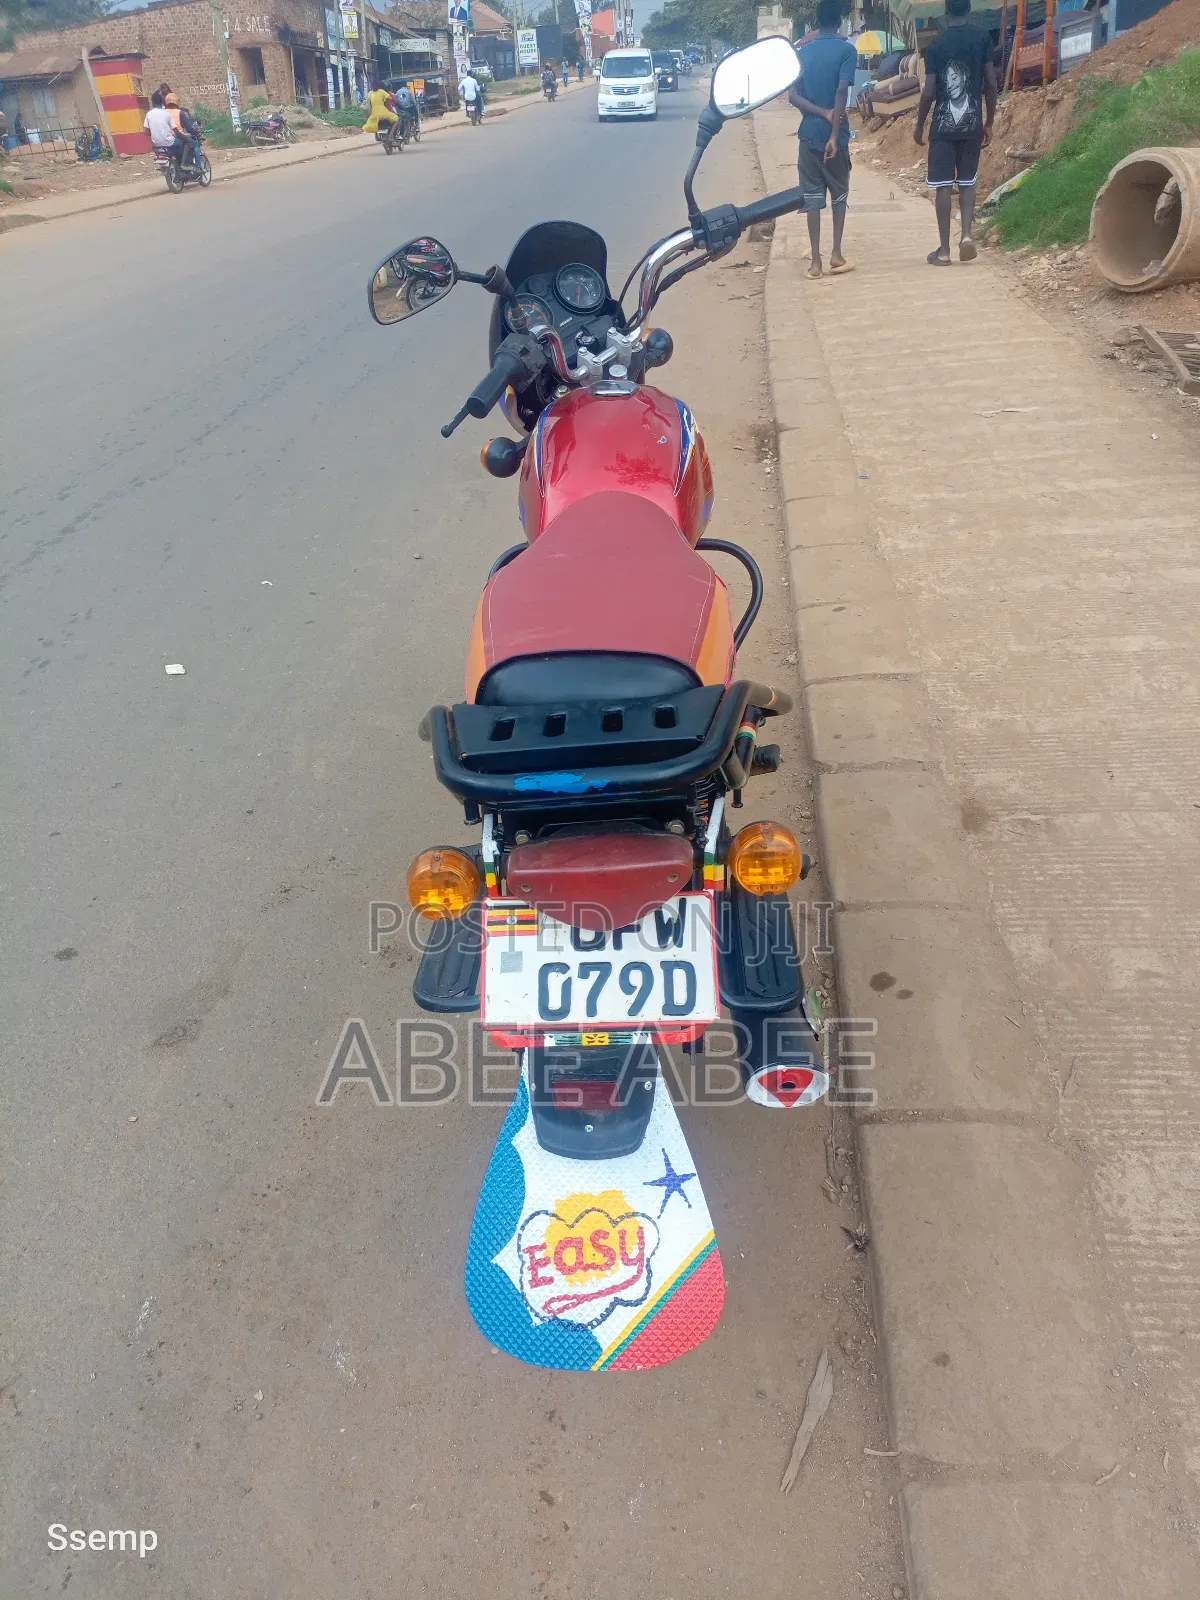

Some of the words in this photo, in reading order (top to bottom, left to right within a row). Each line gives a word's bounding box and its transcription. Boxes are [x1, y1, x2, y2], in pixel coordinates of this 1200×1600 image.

[245, 15, 271, 33] SALE
[538, 961, 697, 1021] 079D
[523, 1224, 646, 1315] Easy
